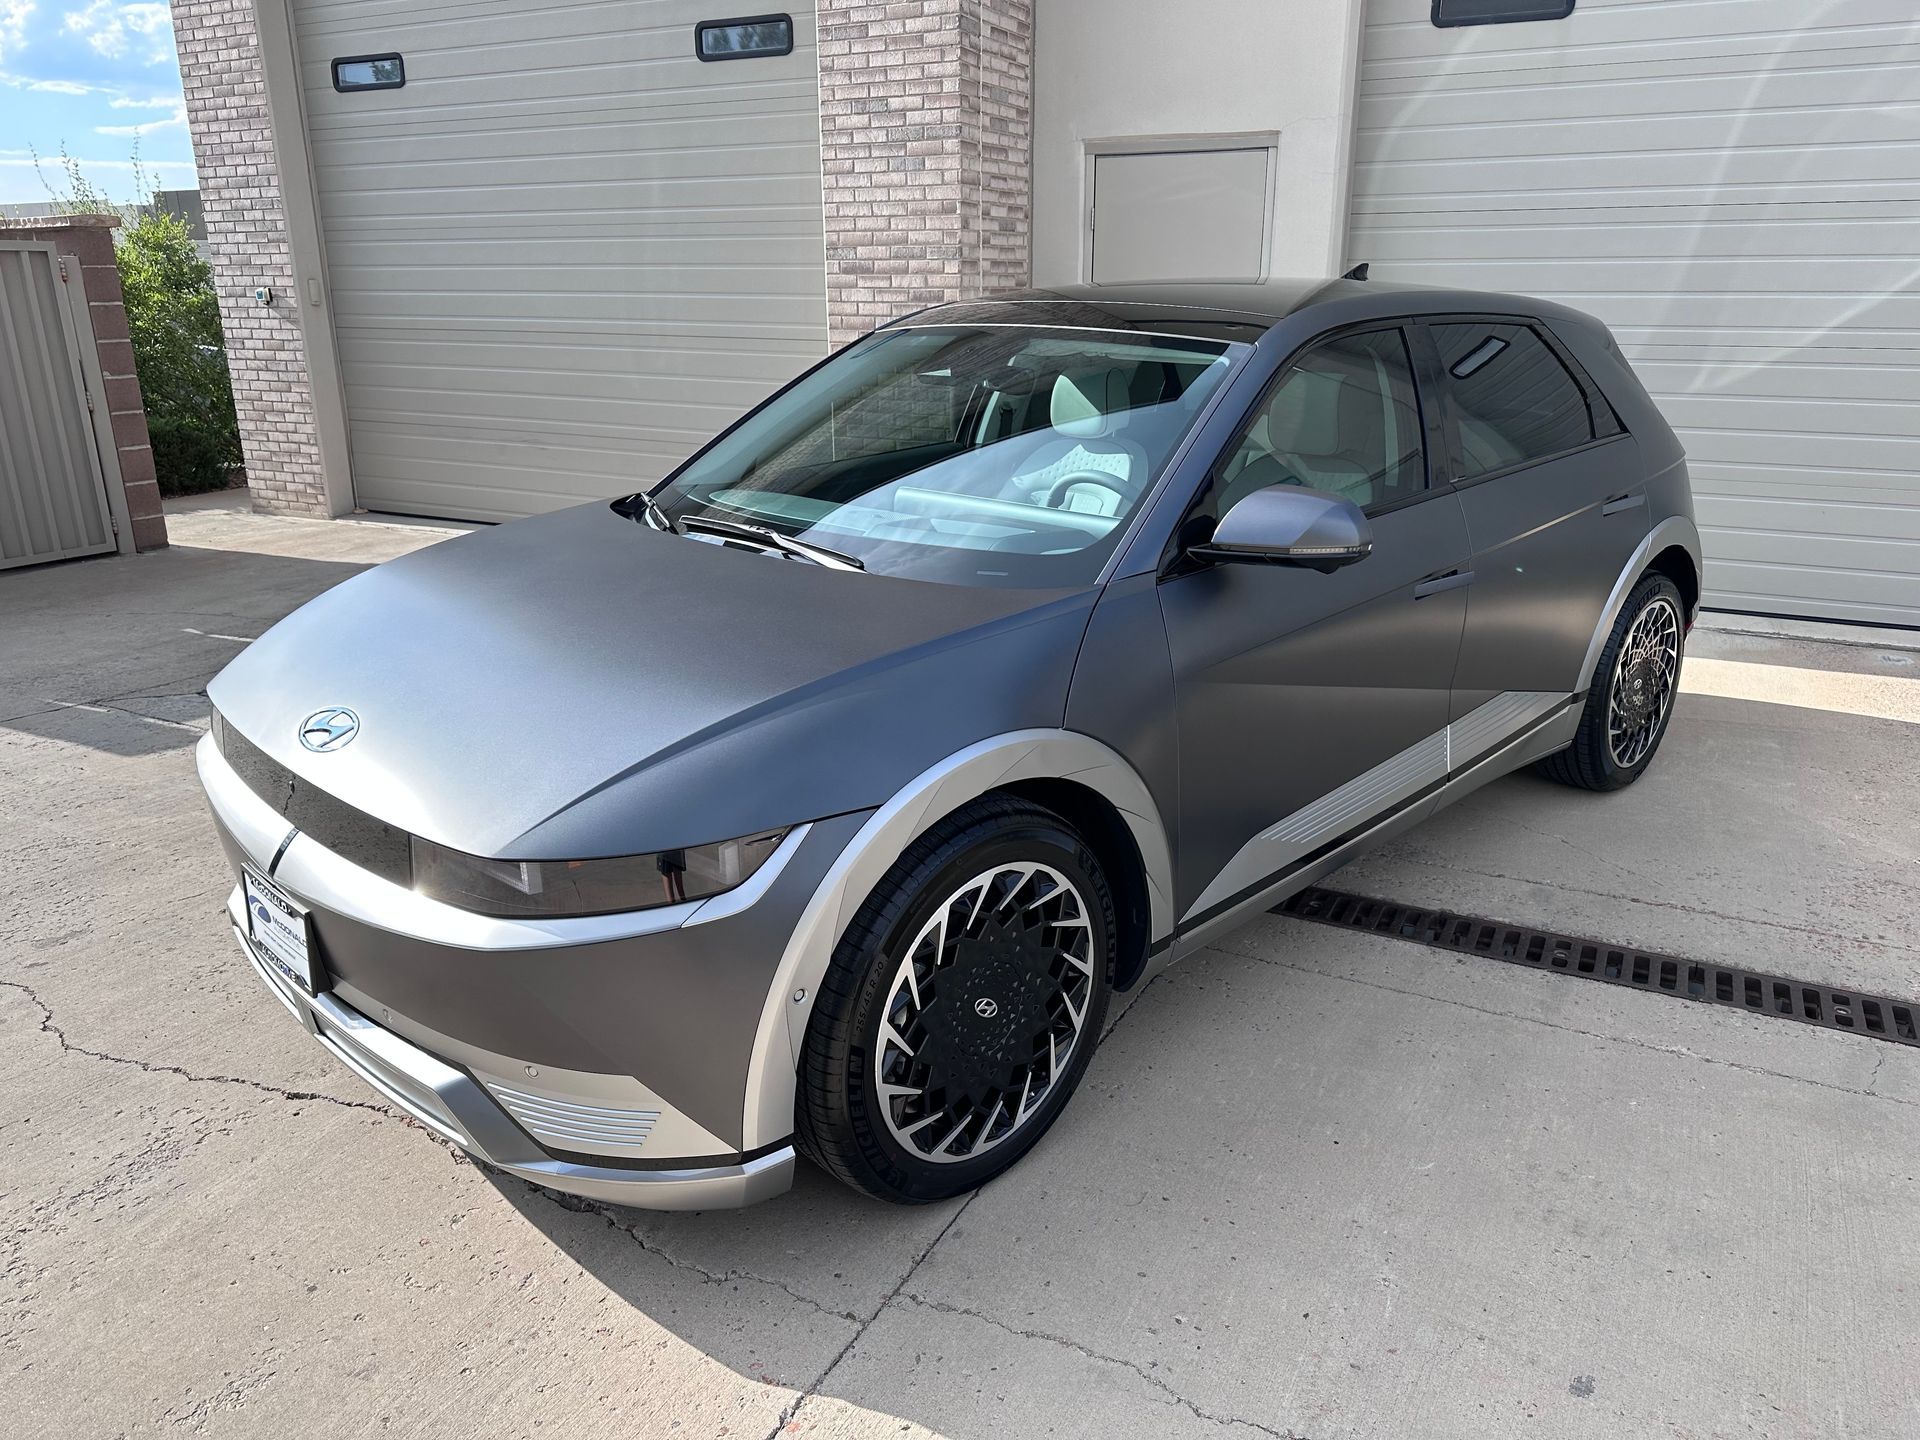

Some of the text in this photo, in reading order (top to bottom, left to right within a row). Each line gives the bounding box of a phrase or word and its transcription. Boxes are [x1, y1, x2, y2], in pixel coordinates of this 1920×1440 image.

[856, 961, 884, 1033] 255/45 R 20
[848, 1054, 890, 1175] MICHELIN
